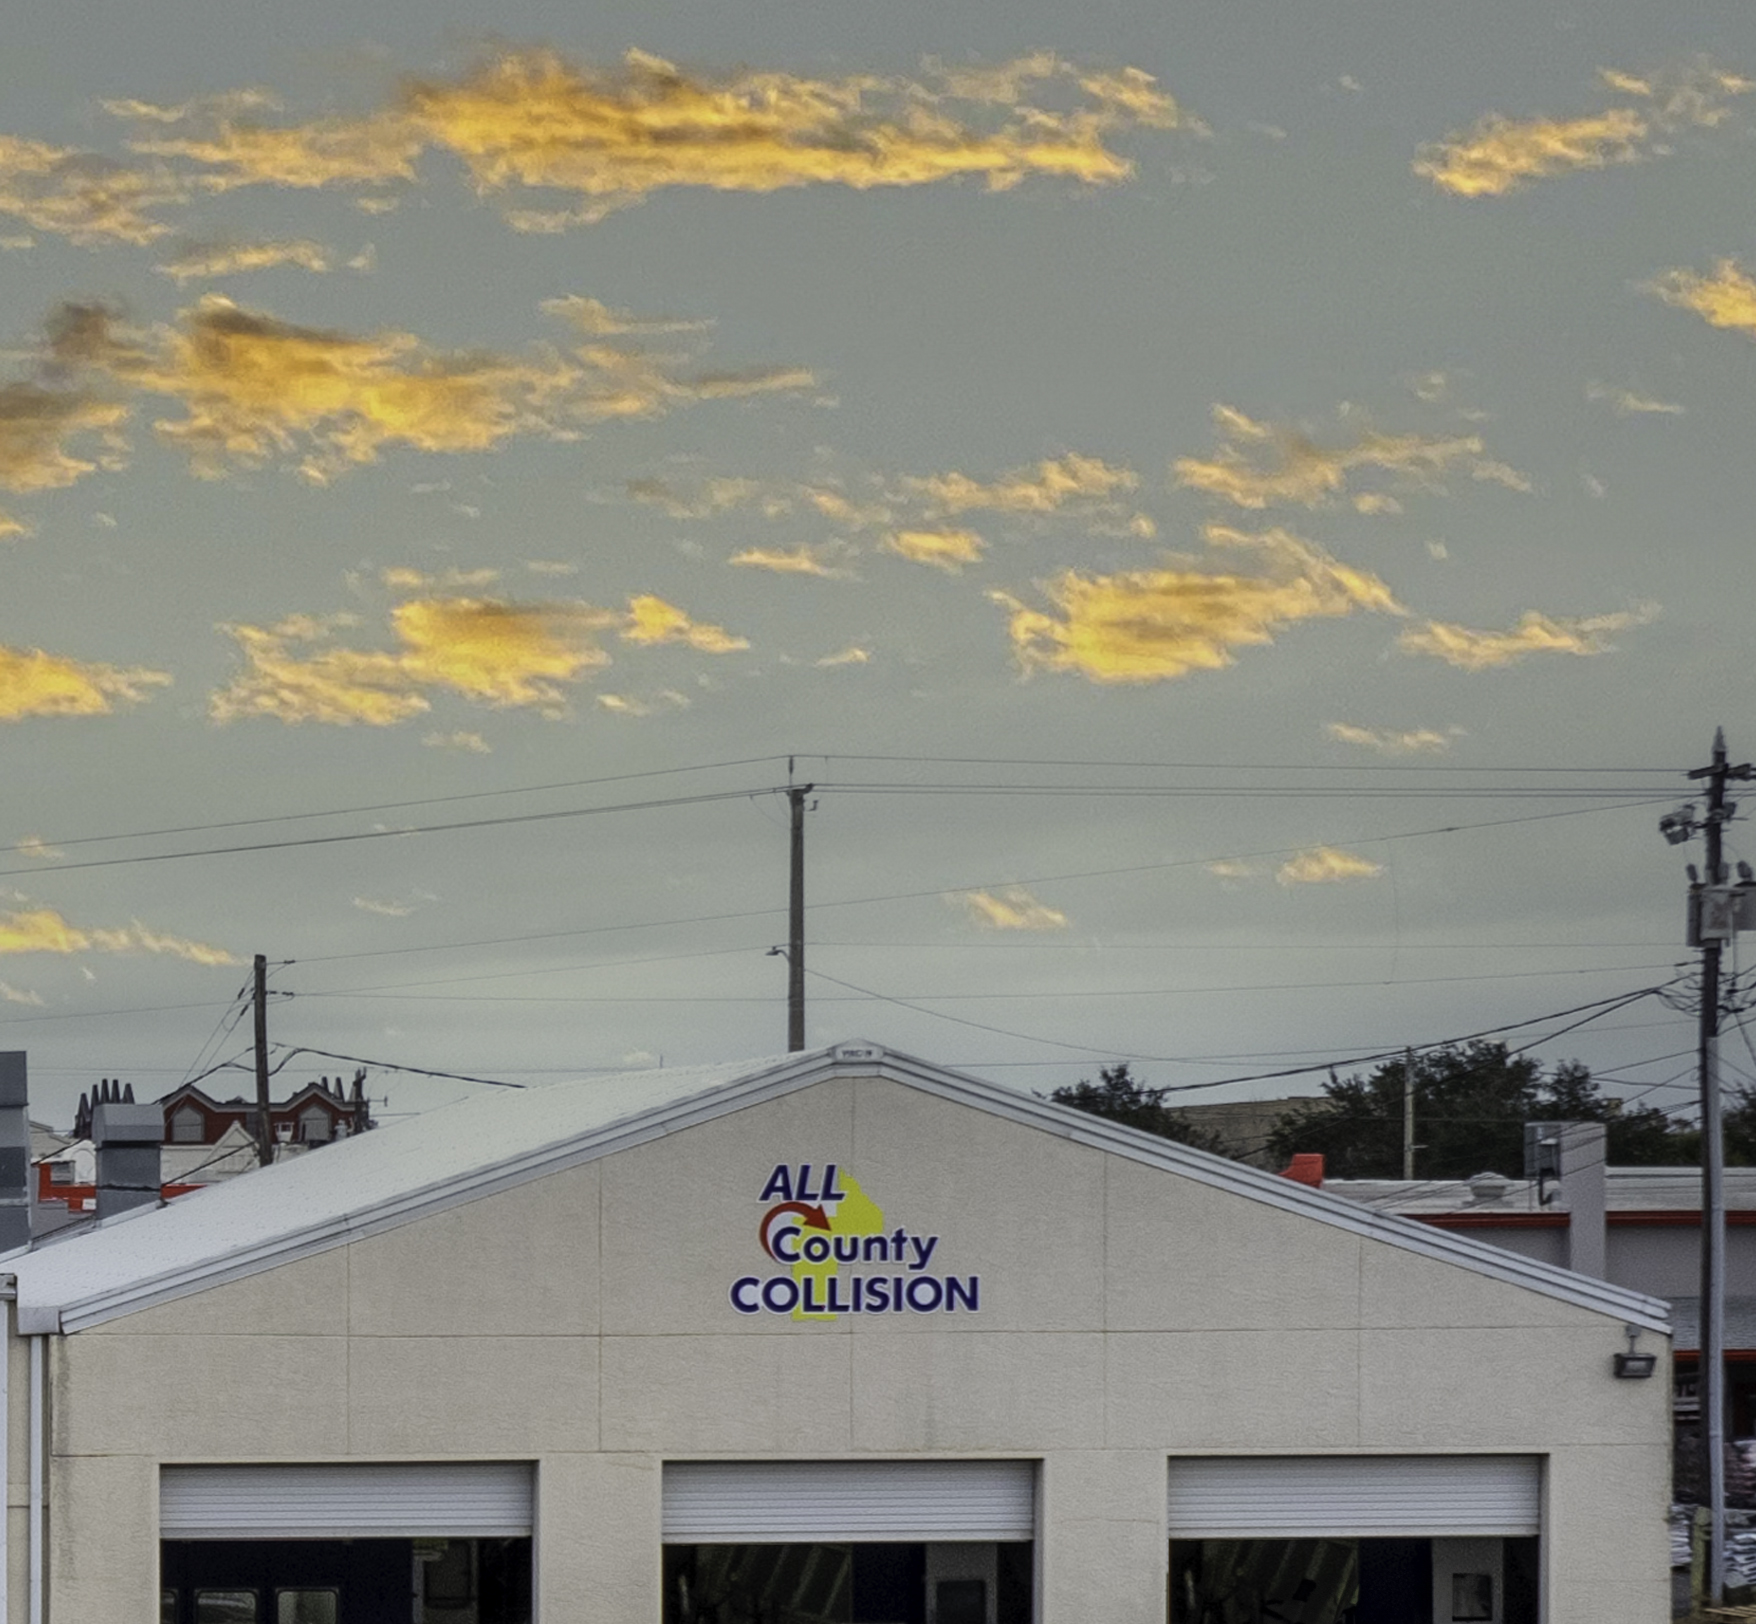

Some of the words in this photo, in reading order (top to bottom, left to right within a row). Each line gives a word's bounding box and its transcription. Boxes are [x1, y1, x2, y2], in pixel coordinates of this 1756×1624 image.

[758, 1163, 847, 1202] ALL
[771, 1225, 940, 1271] County
[729, 1274, 981, 1314] COLLISION
